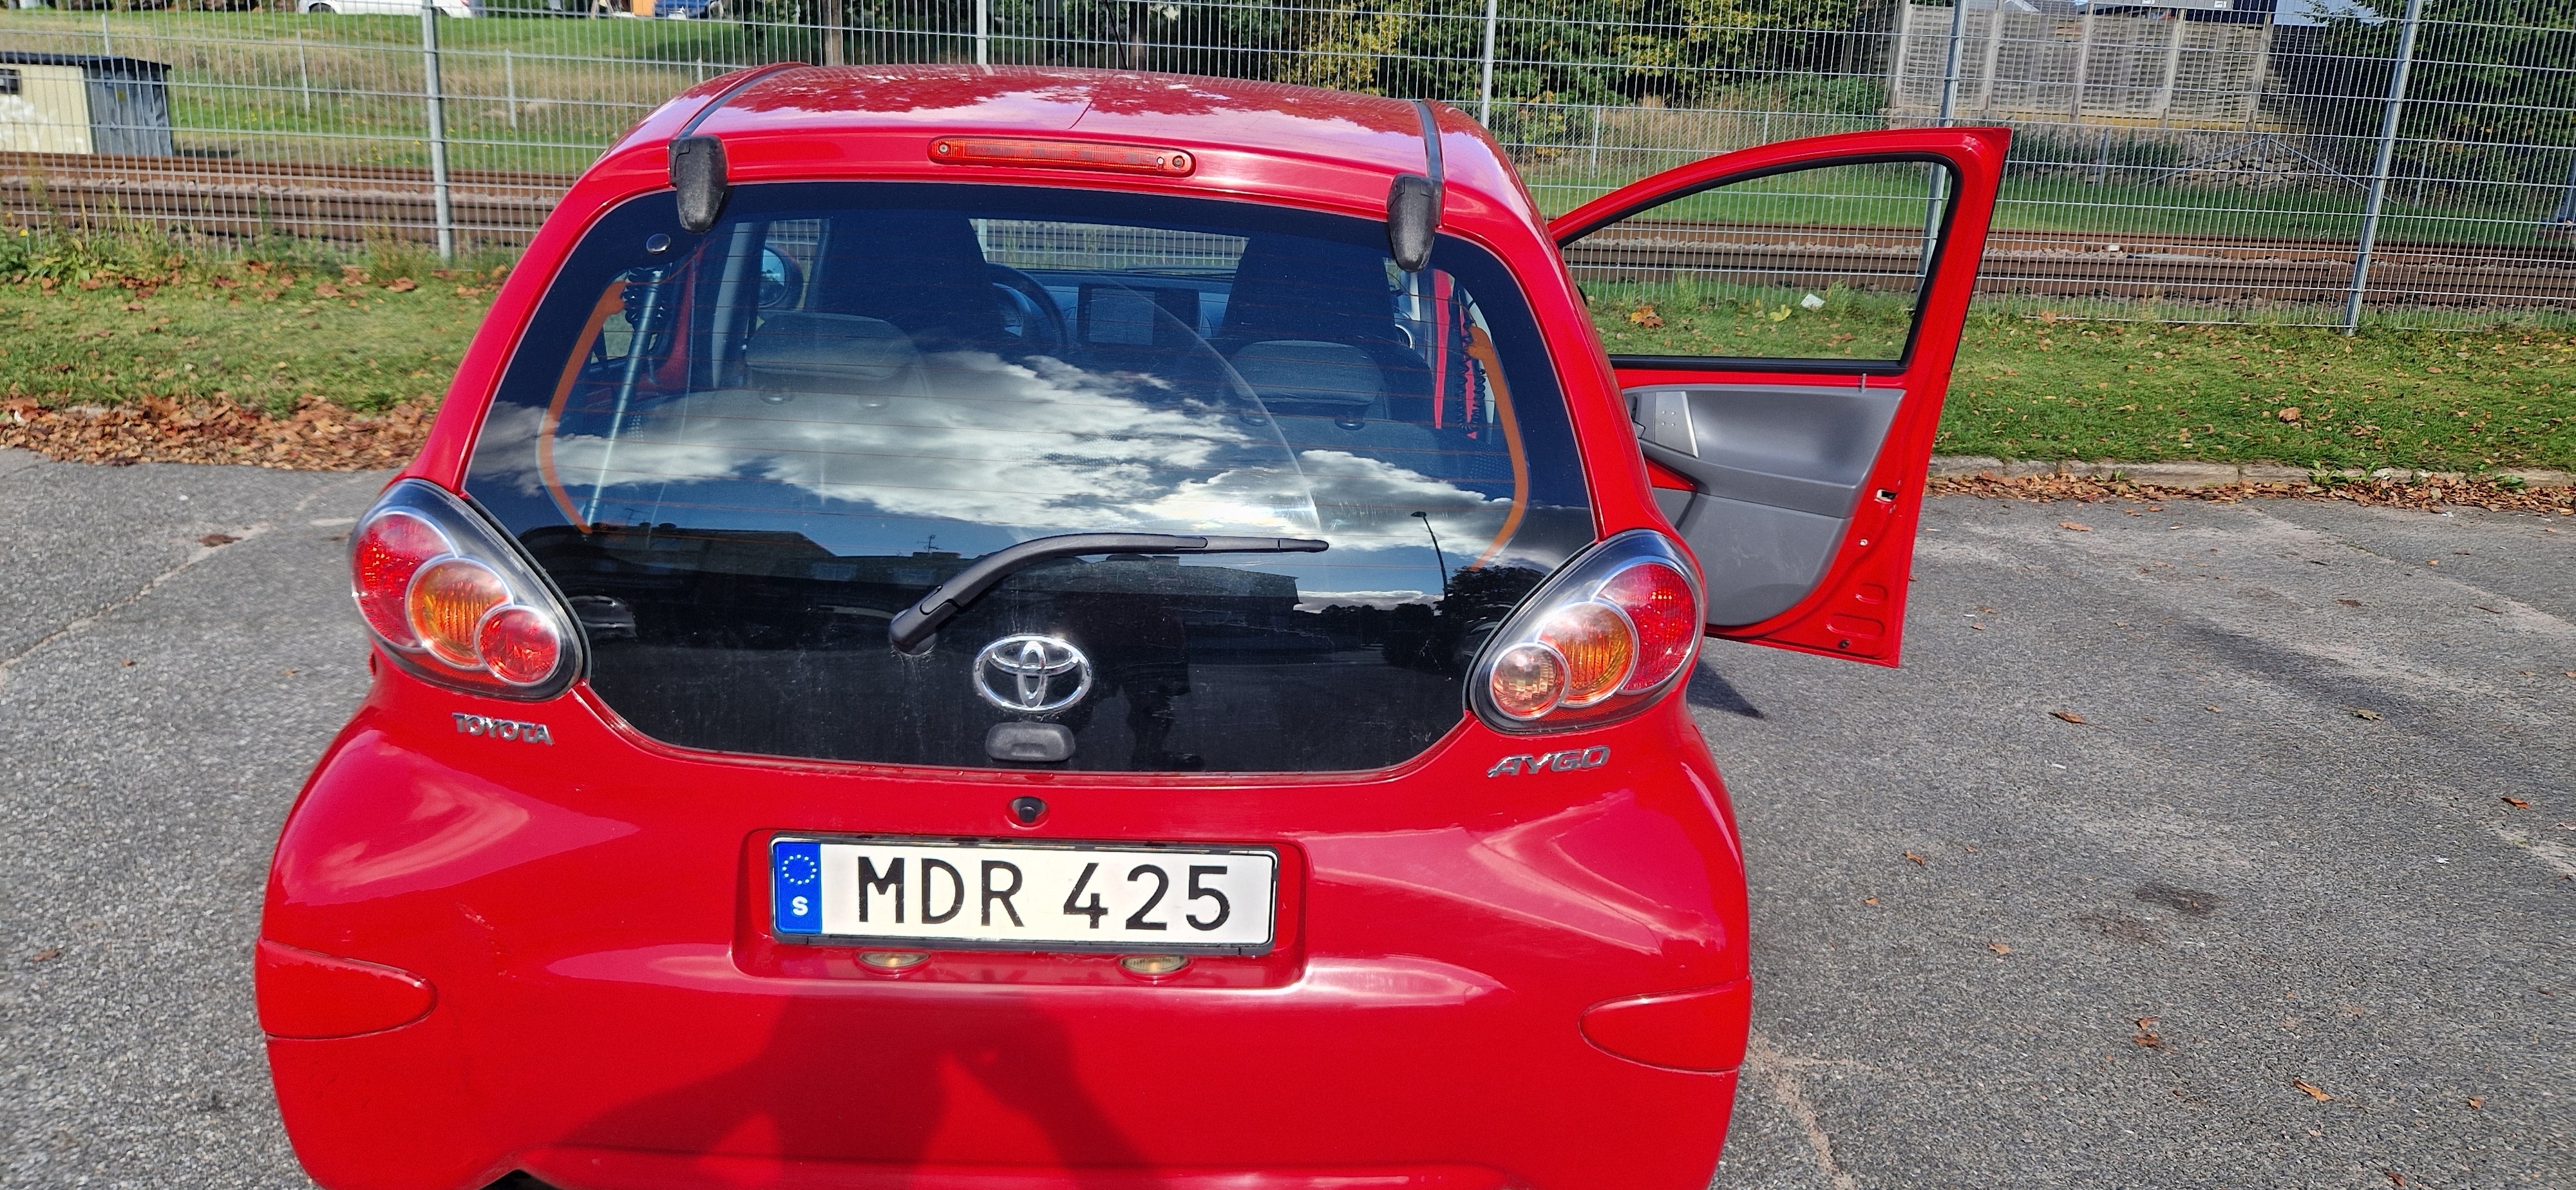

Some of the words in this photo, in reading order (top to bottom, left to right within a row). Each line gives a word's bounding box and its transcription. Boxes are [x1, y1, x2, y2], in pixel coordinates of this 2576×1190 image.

[451, 712, 555, 746] TOYOTA
[1487, 744, 1610, 777] AYGO
[792, 896, 808, 916] S
[858, 856, 1025, 927] MDR
[1063, 862, 1231, 931] 425
